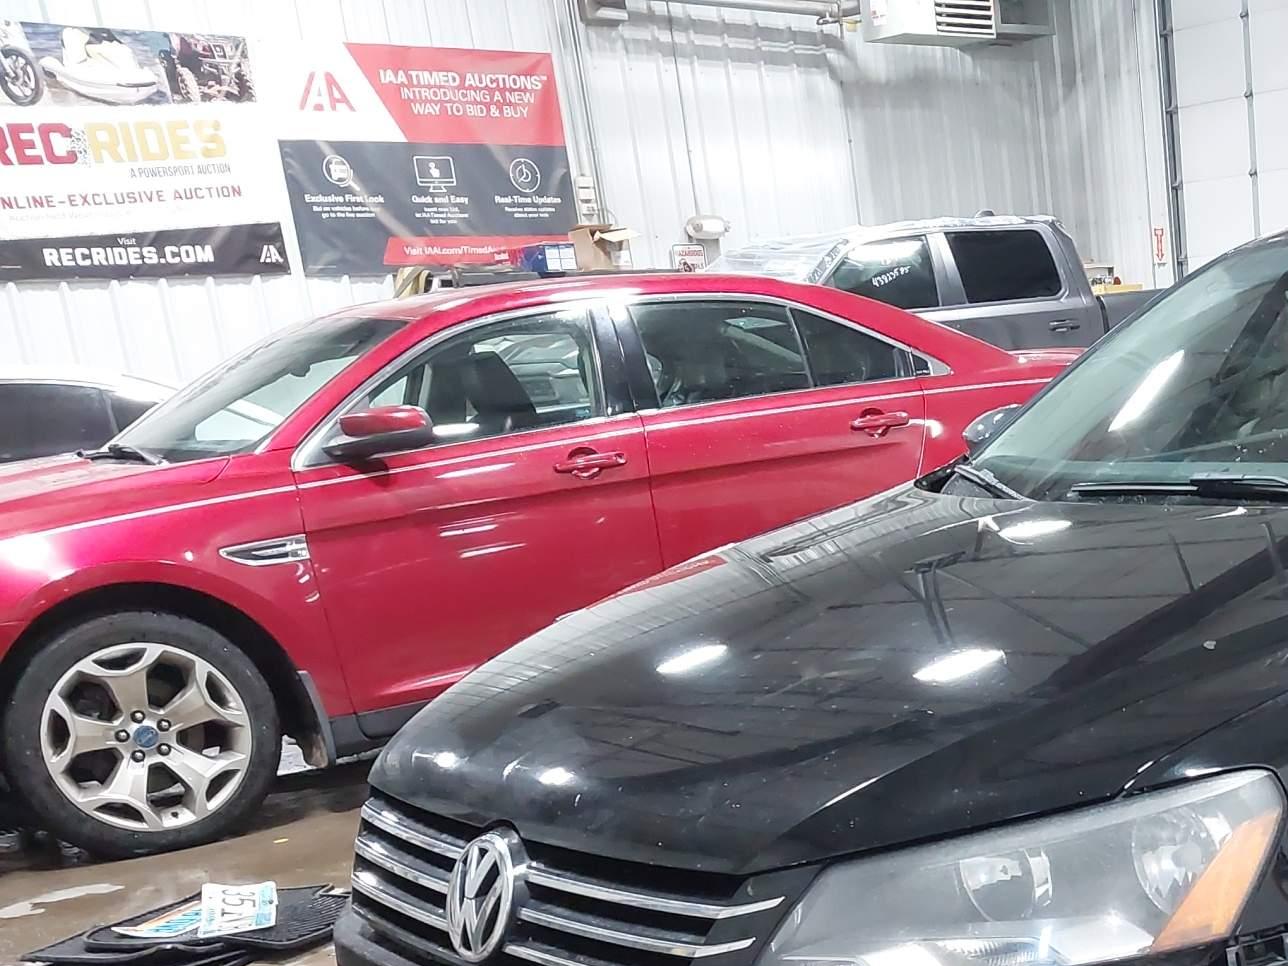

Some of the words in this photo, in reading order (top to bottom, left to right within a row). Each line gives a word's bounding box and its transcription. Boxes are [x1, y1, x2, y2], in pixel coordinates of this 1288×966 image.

[379, 69, 407, 84] IAA
[407, 70, 459, 87] TIMED
[400, 86, 490, 103] INTRODUCING
[493, 90, 503, 103] A
[506, 91, 534, 104] NEW
[410, 102, 440, 115] WAY
[444, 103, 463, 116] TO
[466, 104, 487, 117] BID
[490, 105, 500, 117] &
[503, 105, 529, 118] BUY
[84, 119, 227, 165] RIDES
[130, 167, 137, 178] A
[138, 165, 195, 178] POWERSPORT
[197, 162, 232, 175] AUCTION
[0, 190, 166, 210] NLINE-EXCLUSIVE
[174, 184, 243, 202] AUCTION
[304, 193, 344, 203] Exclusive
[411, 195, 433, 203] Quick
[449, 195, 469, 205] Easy
[494, 195, 532, 204] Real-Time
[532, 195, 562, 205] Updates
[117, 237, 137, 246] Visit
[43, 244, 214, 267] RECRIDES.COM
[403, 246, 423, 256] Visit
